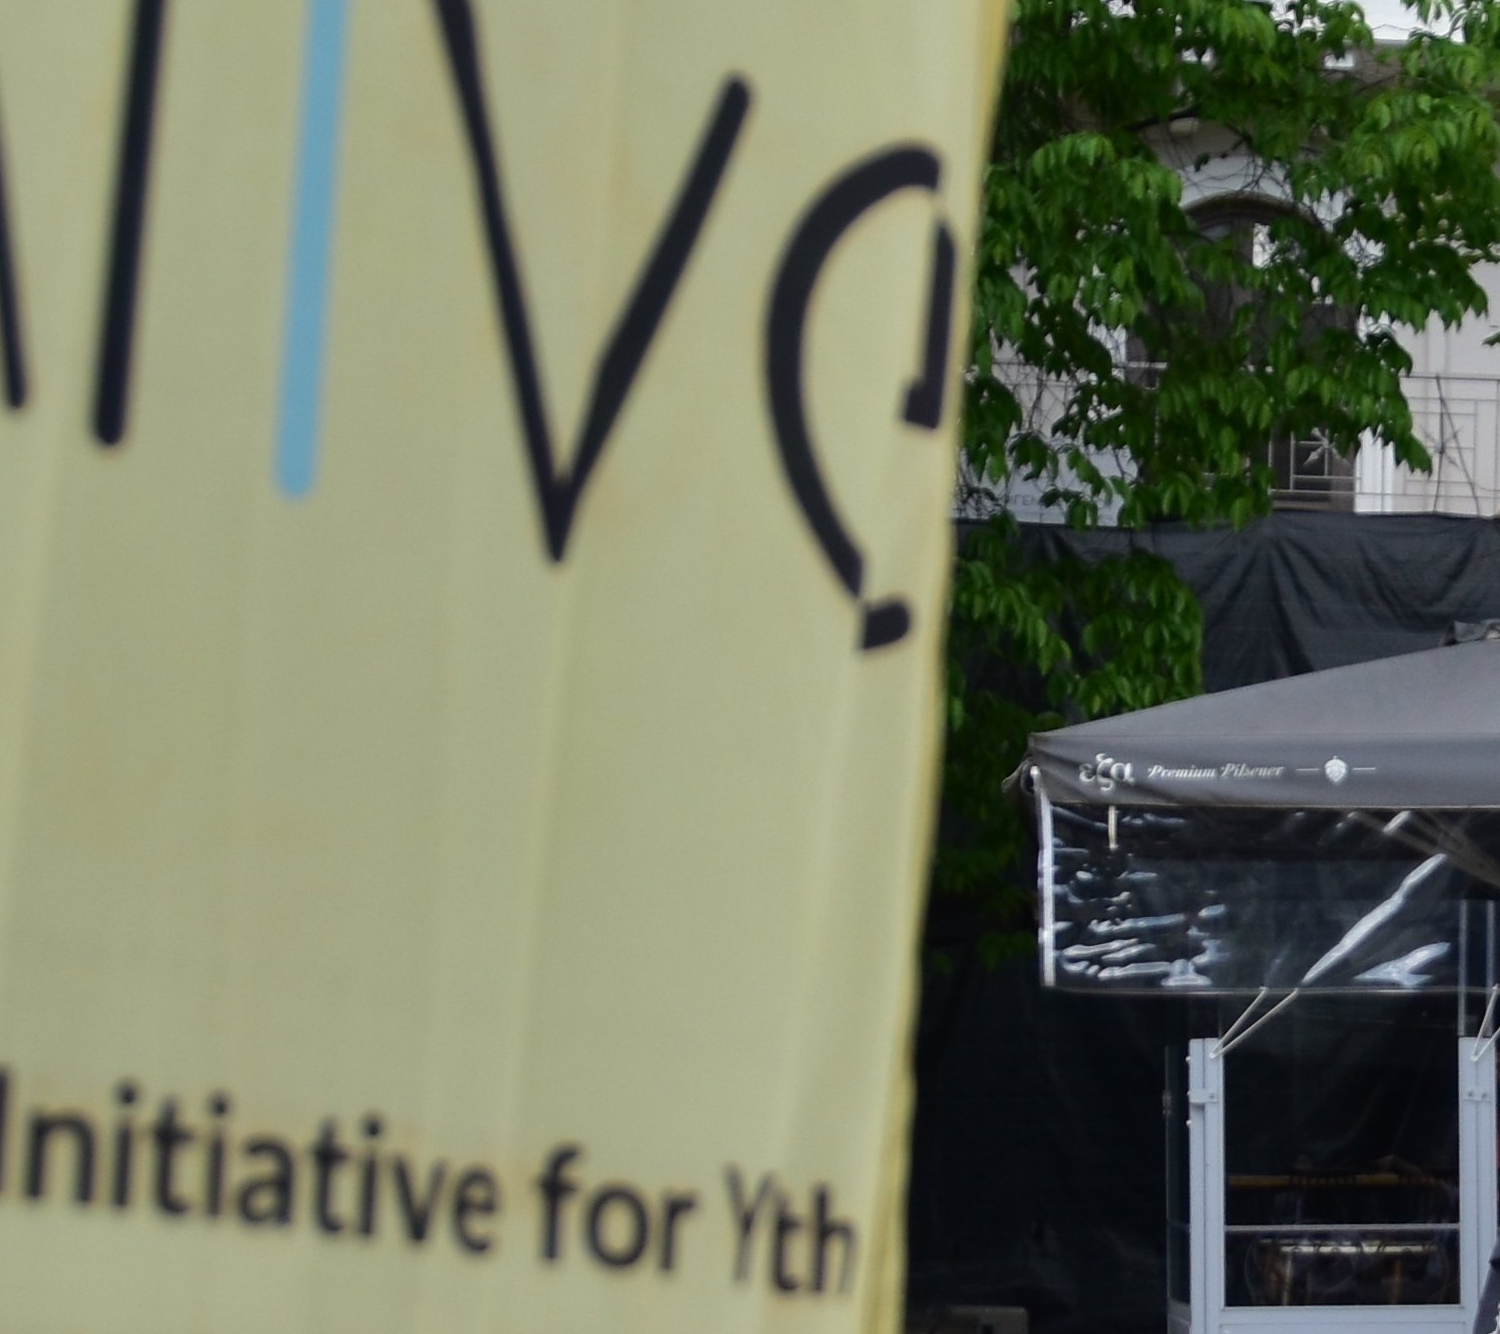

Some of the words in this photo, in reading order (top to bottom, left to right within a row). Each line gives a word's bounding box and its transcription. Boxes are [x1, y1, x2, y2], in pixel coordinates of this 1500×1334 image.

[1147, 763, 1216, 779] Premium
[1219, 762, 1285, 778] Pilsener
[535, 1143, 697, 1273] for
